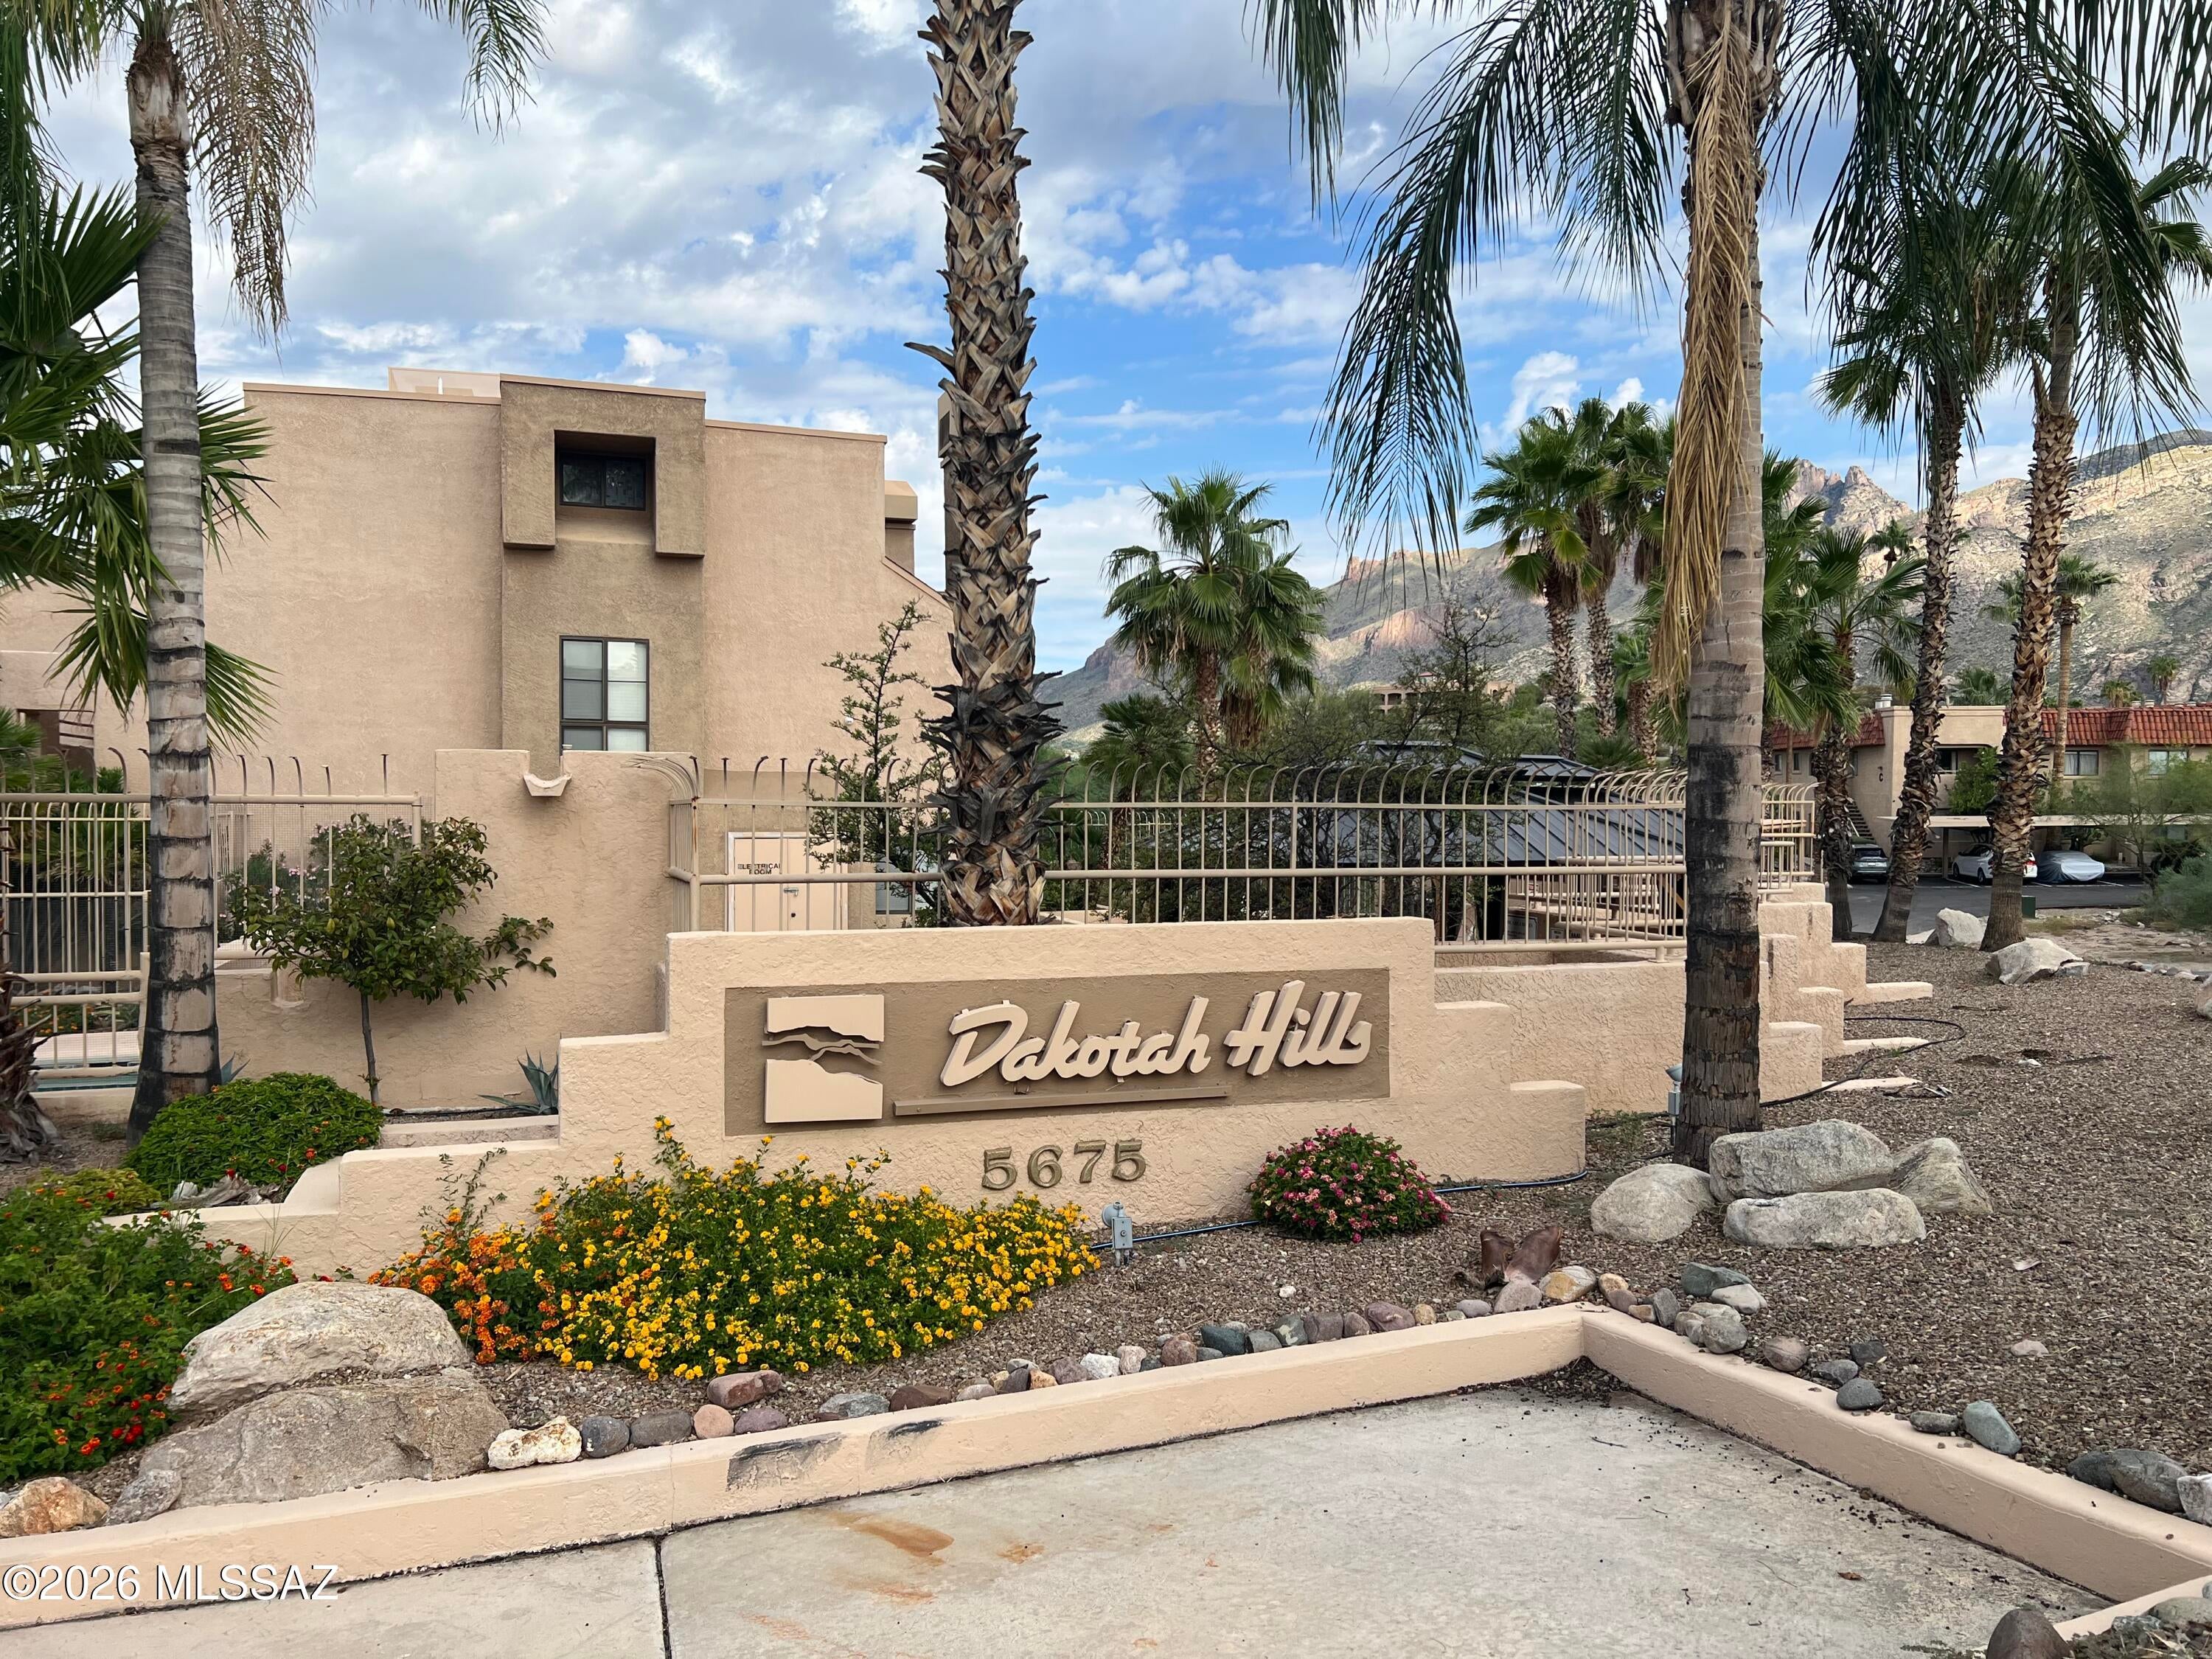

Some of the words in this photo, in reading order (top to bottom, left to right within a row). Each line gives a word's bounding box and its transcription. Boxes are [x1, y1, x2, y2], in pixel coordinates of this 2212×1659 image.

[941, 995, 1211, 1087] Dakotah
[1223, 979, 1372, 1077] Hills
[981, 1138, 1147, 1191] 5675
